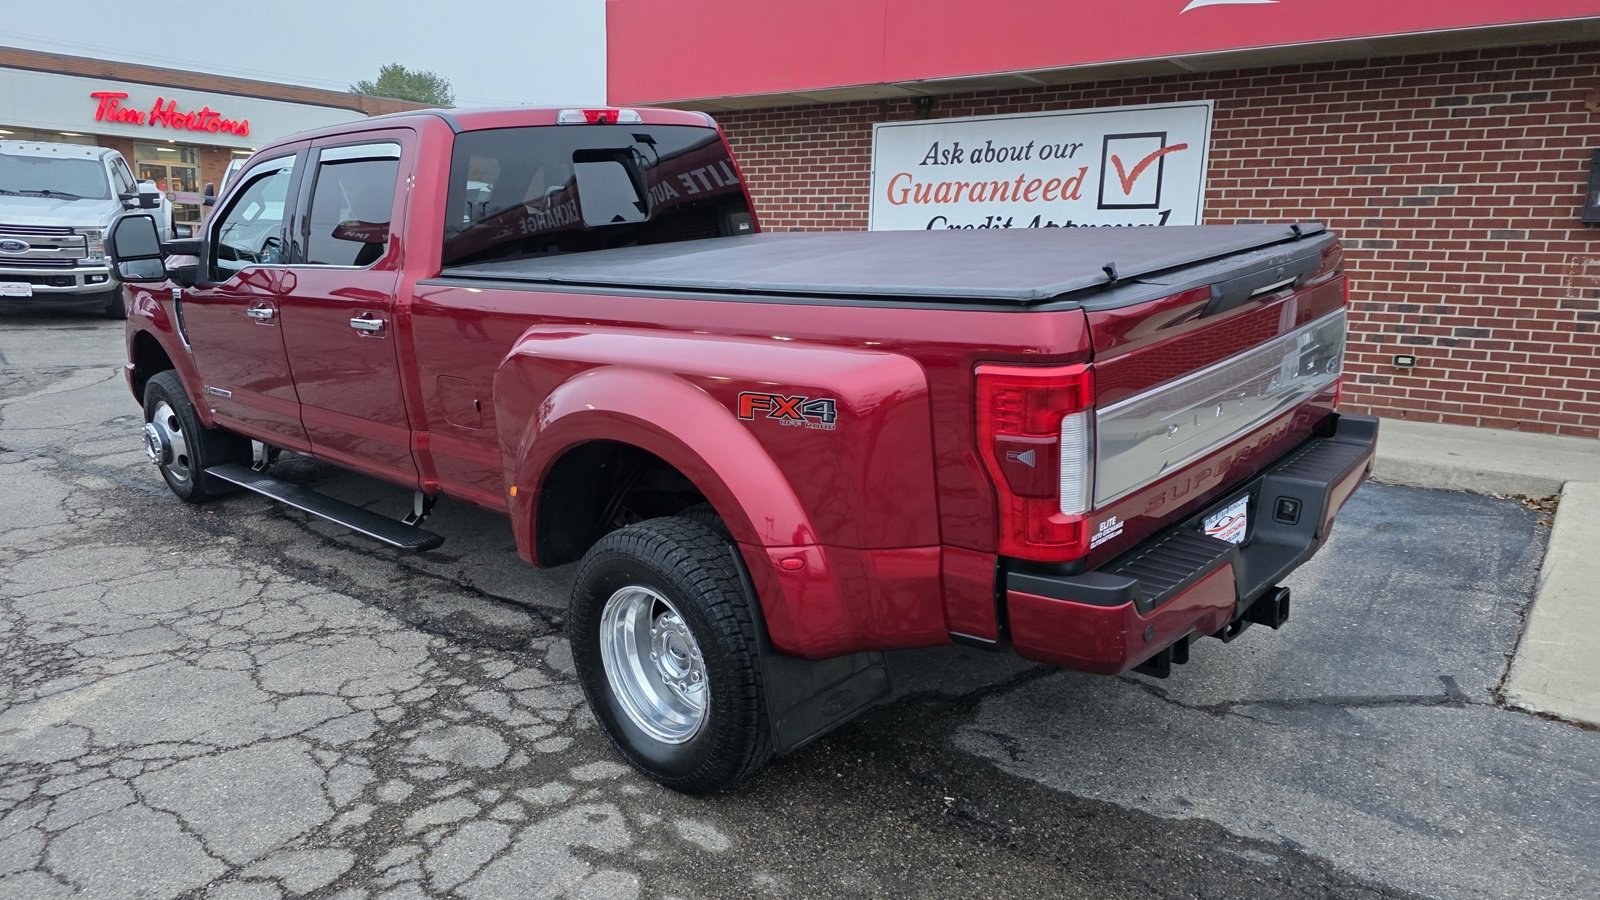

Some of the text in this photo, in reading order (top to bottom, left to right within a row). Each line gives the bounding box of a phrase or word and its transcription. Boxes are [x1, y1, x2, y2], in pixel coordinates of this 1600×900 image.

[90, 92, 249, 136] Tim Hortons
[919, 140, 1083, 166] Ask about our
[887, 166, 1088, 206] Guaranteed
[738, 391, 837, 424] FX4
[1144, 445, 1252, 514] SUPER
[1099, 515, 1117, 532] ELITE
